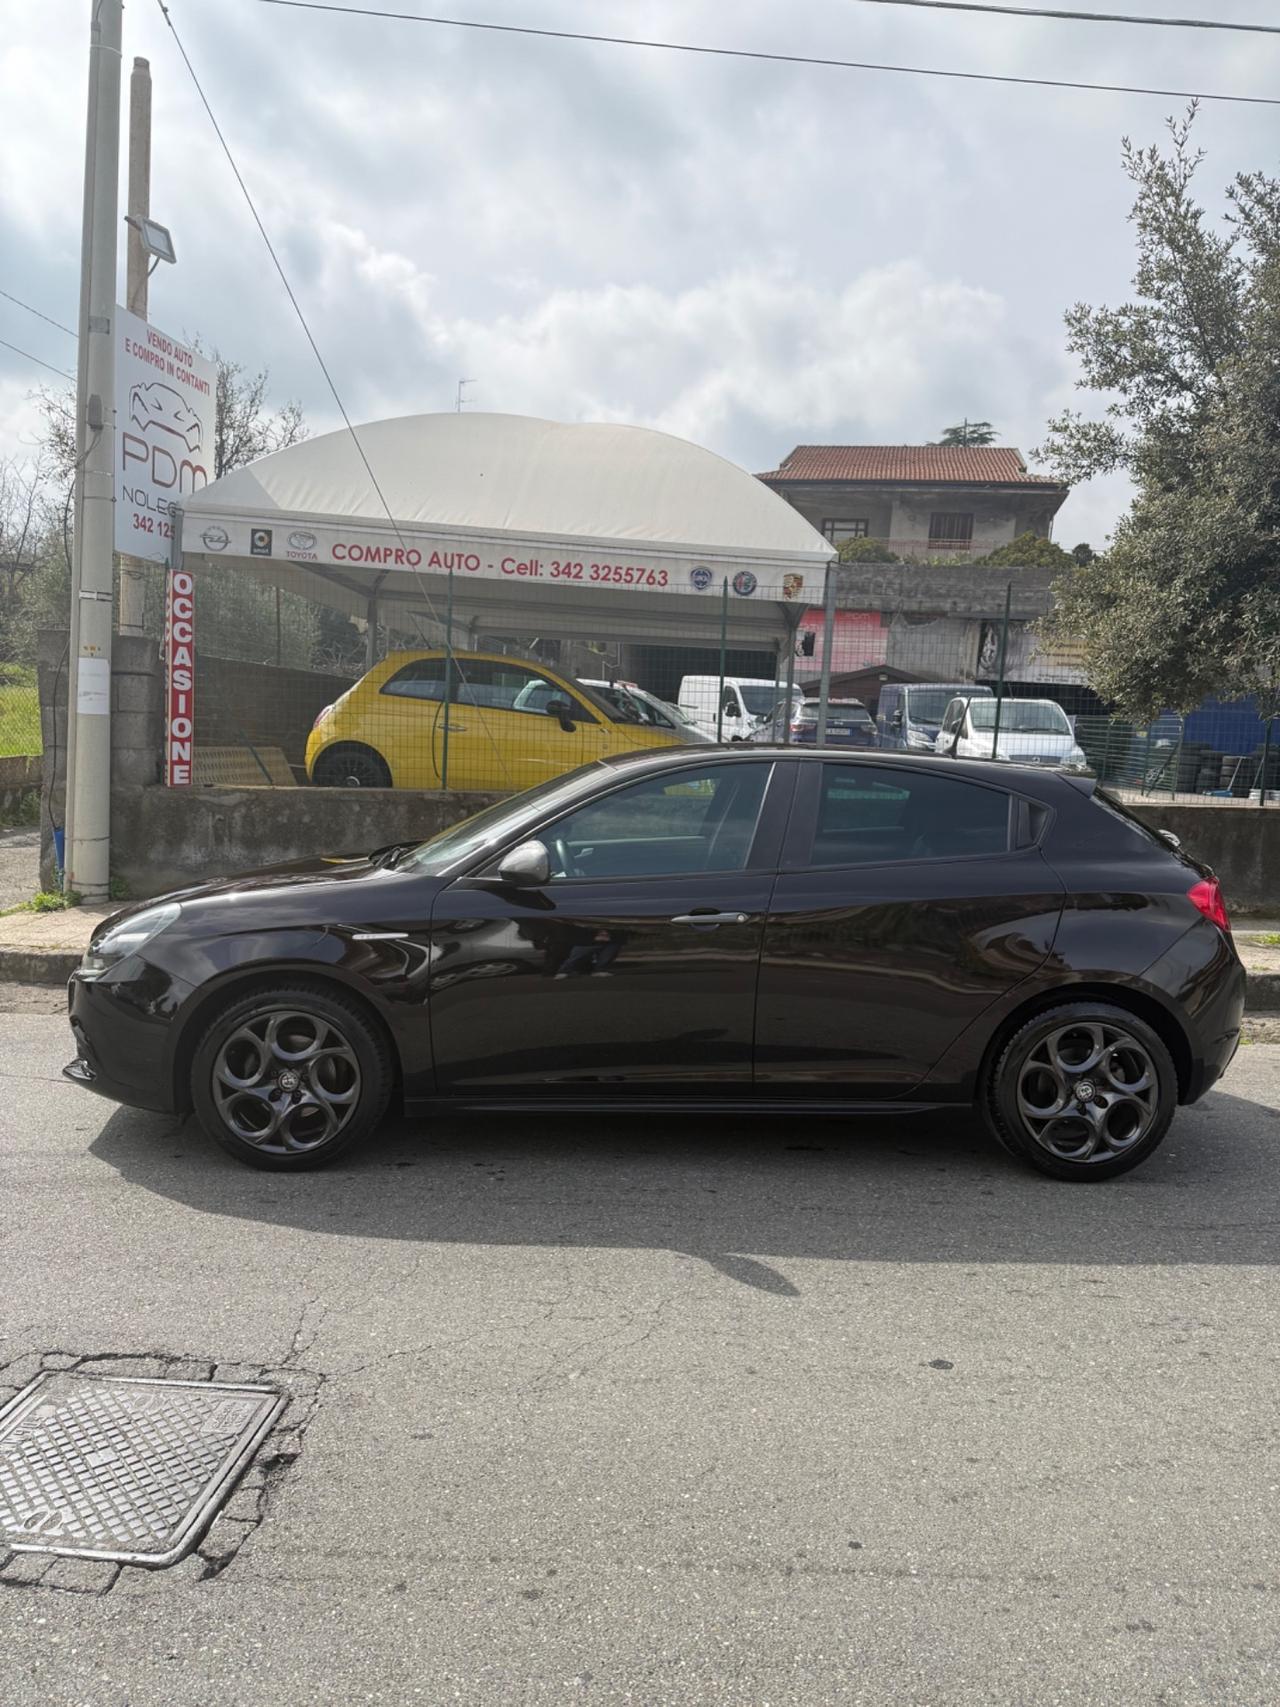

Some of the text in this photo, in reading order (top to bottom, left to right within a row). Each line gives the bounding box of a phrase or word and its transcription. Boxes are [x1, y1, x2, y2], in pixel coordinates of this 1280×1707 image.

[125, 336, 210, 396] E COMPRO IN CONTANTI
[146, 328, 193, 368] VENDO AUTO
[133, 512, 154, 534] 342
[287, 551, 318, 560] TOYOTA
[332, 543, 422, 567] COMPRO
[428, 551, 481, 571] AUTO
[501, 557, 544, 577] Cell:
[550, 561, 583, 580] 342
[589, 563, 669, 587] 3255763
[171, 573, 193, 784] OCCASIONE
